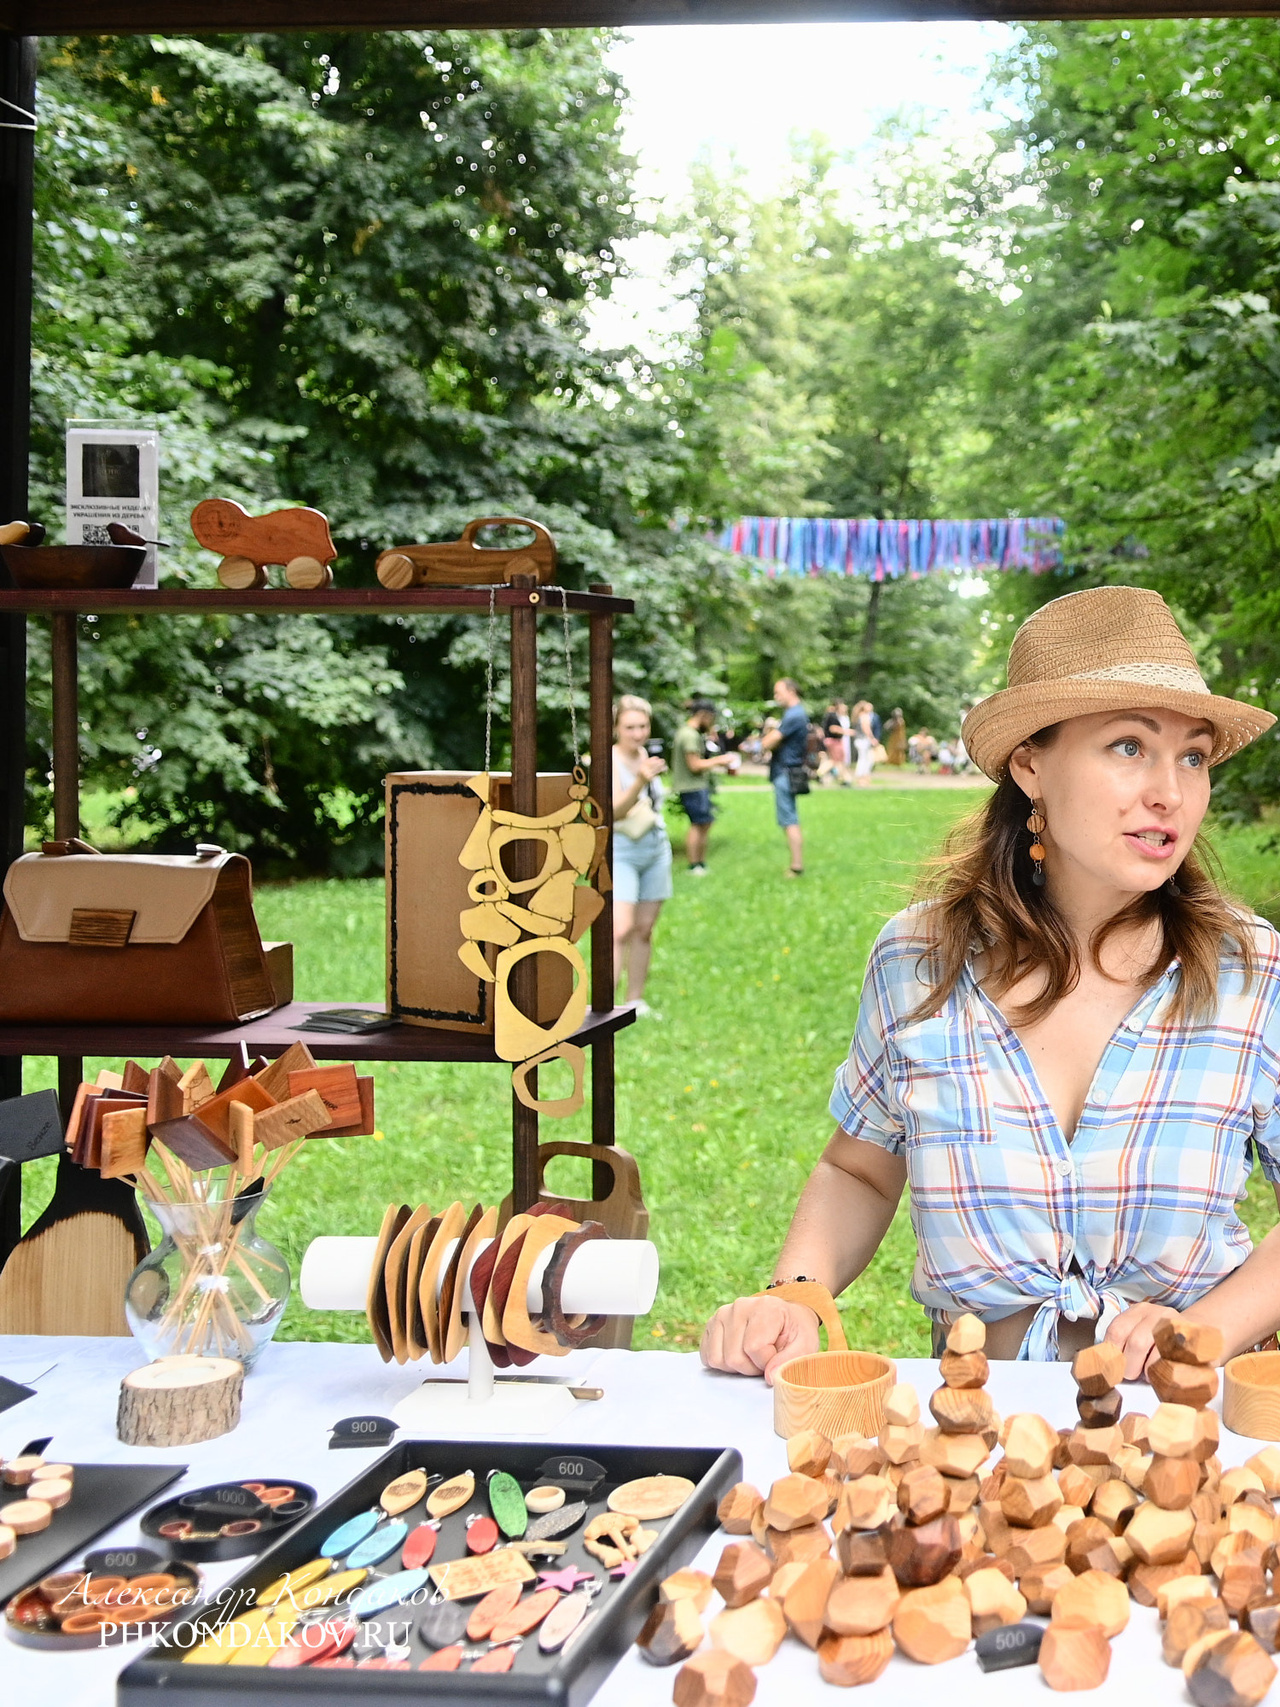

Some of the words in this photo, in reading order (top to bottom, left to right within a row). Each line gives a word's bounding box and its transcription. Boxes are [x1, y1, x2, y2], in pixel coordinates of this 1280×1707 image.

[351, 1421, 377, 1433] 900
[559, 1461, 584, 1476] 600
[216, 1489, 246, 1506] 1000
[105, 1552, 136, 1567] 600
[995, 1630, 1026, 1651] 500
